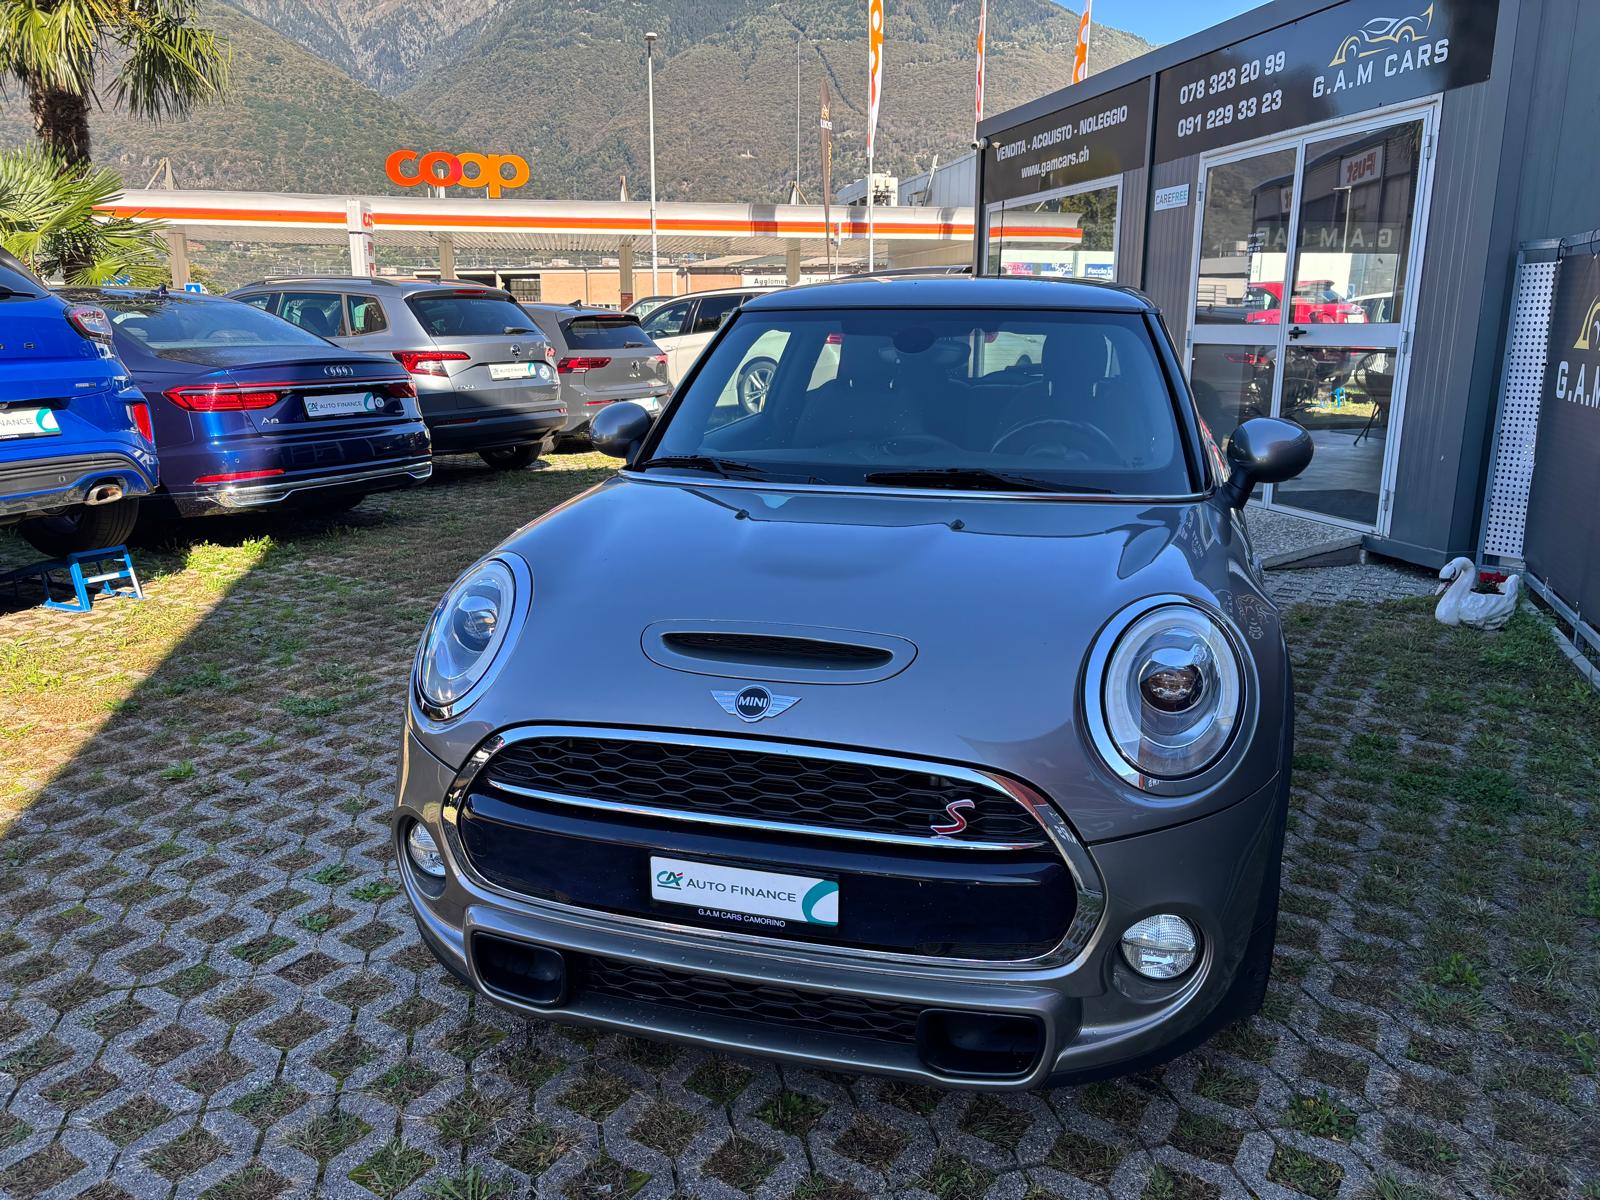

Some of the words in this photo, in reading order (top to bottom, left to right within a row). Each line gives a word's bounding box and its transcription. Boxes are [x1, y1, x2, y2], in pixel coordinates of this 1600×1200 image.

[1180, 79, 1205, 104] 078
[1208, 68, 1236, 95] 323
[1240, 60, 1260, 84] 20
[1264, 51, 1286, 76] 99
[1312, 60, 1374, 98] G.A.M
[1384, 38, 1449, 77] CARS
[1177, 114, 1202, 137] 091
[1206, 104, 1233, 129] 229
[1237, 97, 1257, 120] 33
[1261, 89, 1282, 113] 23
[996, 139, 1027, 162] VENDITA
[1031, 124, 1072, 150] ACQUISTO
[1079, 105, 1128, 135] NOLEGGIO
[385, 150, 530, 199] coop
[1021, 145, 1090, 179] www.gamcars.ch
[1155, 190, 1188, 205] CAREFREE
[337, 400, 362, 408] FINANCE
[738, 695, 768, 708] MINI
[930, 799, 975, 835] S
[686, 878, 727, 893] AUTO
[730, 884, 798, 903] FINANCE
[698, 908, 720, 919] G.A.M
[720, 911, 743, 922] CARS
[743, 914, 787, 928] CAMORINO
